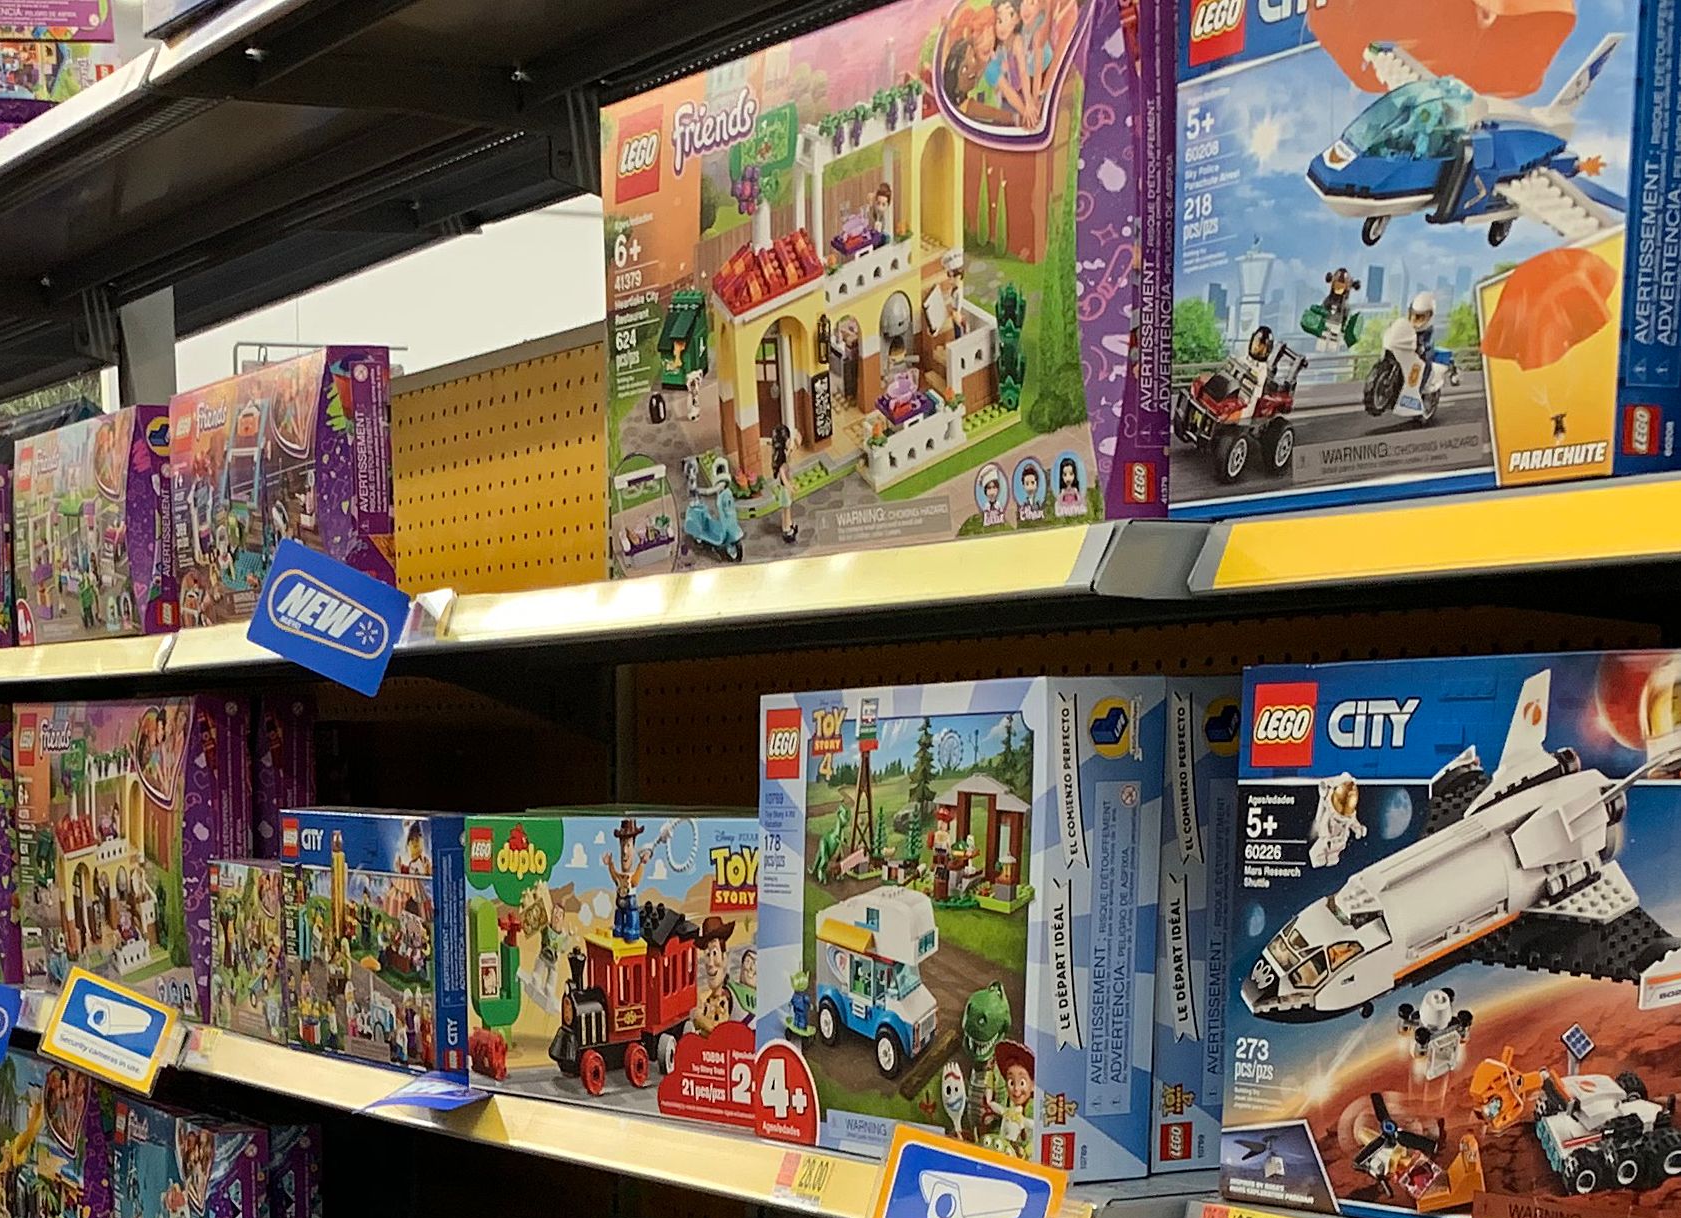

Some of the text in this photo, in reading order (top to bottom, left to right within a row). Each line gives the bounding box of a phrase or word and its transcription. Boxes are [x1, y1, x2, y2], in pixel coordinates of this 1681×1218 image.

[1194, 0, 1241, 41] LEGO
[619, 86, 757, 176] LEGO Friends
[1186, 108, 1215, 140] 5+
[1184, 193, 1212, 220] 218
[614, 235, 641, 268] 6+
[1634, 160, 1659, 345] AVERTISSEMENT
[614, 272, 642, 292] 41379
[616, 328, 637, 351] 624
[1140, 253, 1154, 412] AVERTISSEMENT
[196, 397, 226, 432] Friends
[1632, 408, 1649, 446] LEGO
[355, 411, 364, 513] AVERTISSEMENT
[1509, 441, 1607, 473] PARACHUTE
[1132, 462, 1150, 503] LEGO
[277, 582, 364, 638] NEW
[812, 706, 848, 737] TOY
[1176, 706, 1187, 768] PERFECTO
[1254, 698, 1420, 748] LEGO CITY
[39, 718, 71, 760] Friends
[767, 727, 799, 760] LEGO
[814, 739, 840, 751] STORY
[819, 753, 833, 781] 4
[1061, 706, 1078, 856] EL COMIENZO PERFECTO
[301, 828, 324, 851] CITY
[1246, 809, 1278, 838] 5+
[470, 838, 548, 880] LEGO duplo
[764, 834, 781, 851] 178
[1183, 838, 1192, 852] EL
[1244, 845, 1282, 860] 60226
[710, 846, 759, 891] TOY
[1244, 865, 1302, 879] Mars Research
[1244, 877, 1270, 889] Shuttle
[715, 889, 757, 905] STORY
[1054, 903, 1070, 1030] LE DÉPART IDÉAL
[1171, 898, 1188, 1021] LE DÉPART IDÉAL
[447, 1017, 458, 1046] CITY
[1091, 945, 1105, 1085] AVERTISSEMENT
[59, 1032, 118, 1066] Security cameras
[1236, 1038, 1269, 1060] 273
[682, 1078, 694, 1097] 21
[1234, 1061, 1274, 1082] pcs/pzs
[760, 1058, 808, 1119] 4+
[1048, 1137, 1065, 1168] LEGO
[1170, 1126, 1183, 1157] LEGO
[798, 1156, 828, 1192] 28.00
